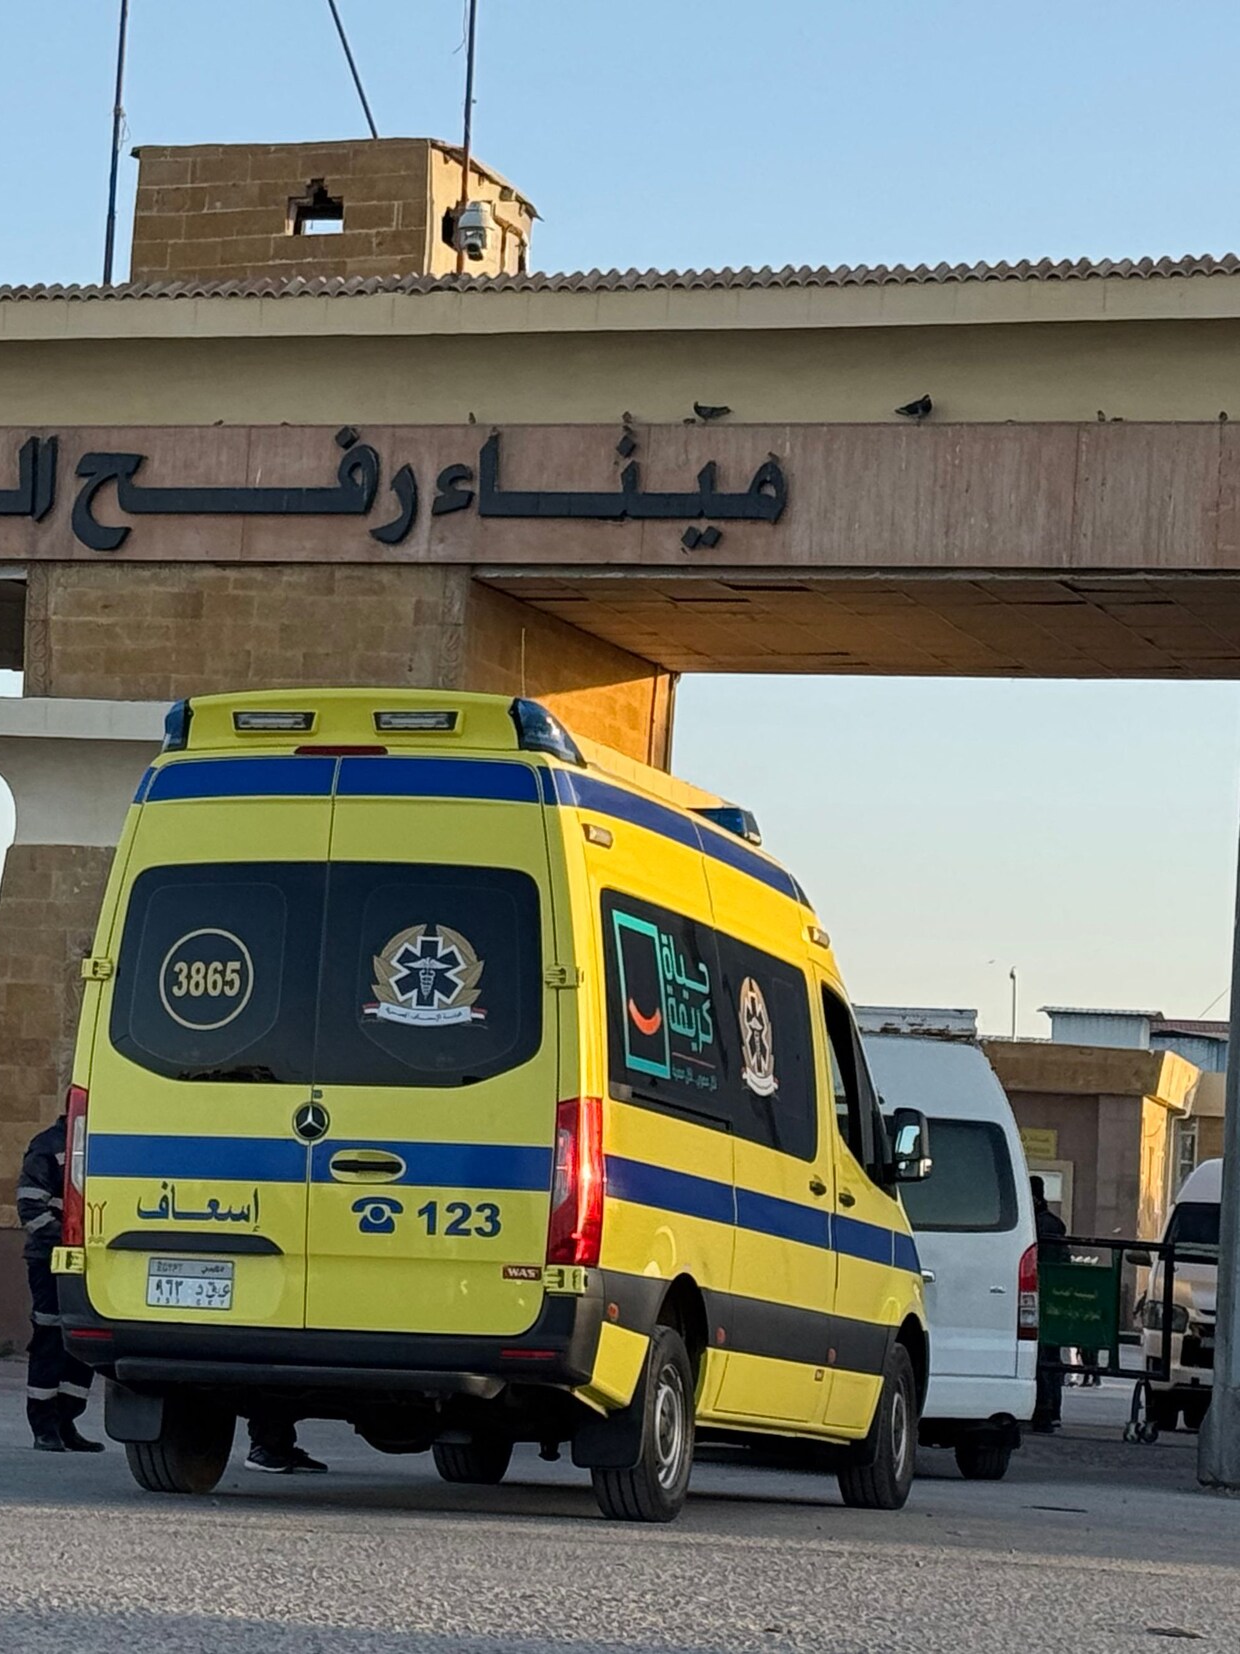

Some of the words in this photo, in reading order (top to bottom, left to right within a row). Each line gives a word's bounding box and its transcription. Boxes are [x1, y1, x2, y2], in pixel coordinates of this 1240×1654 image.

[71, 426, 418, 551] رفح
[431, 433, 787, 549] ميناء
[172, 961, 241, 997] 3865
[137, 1180, 260, 1232] إسعاف
[417, 1201, 502, 1238] 123
[506, 1266, 537, 1279] WAS
